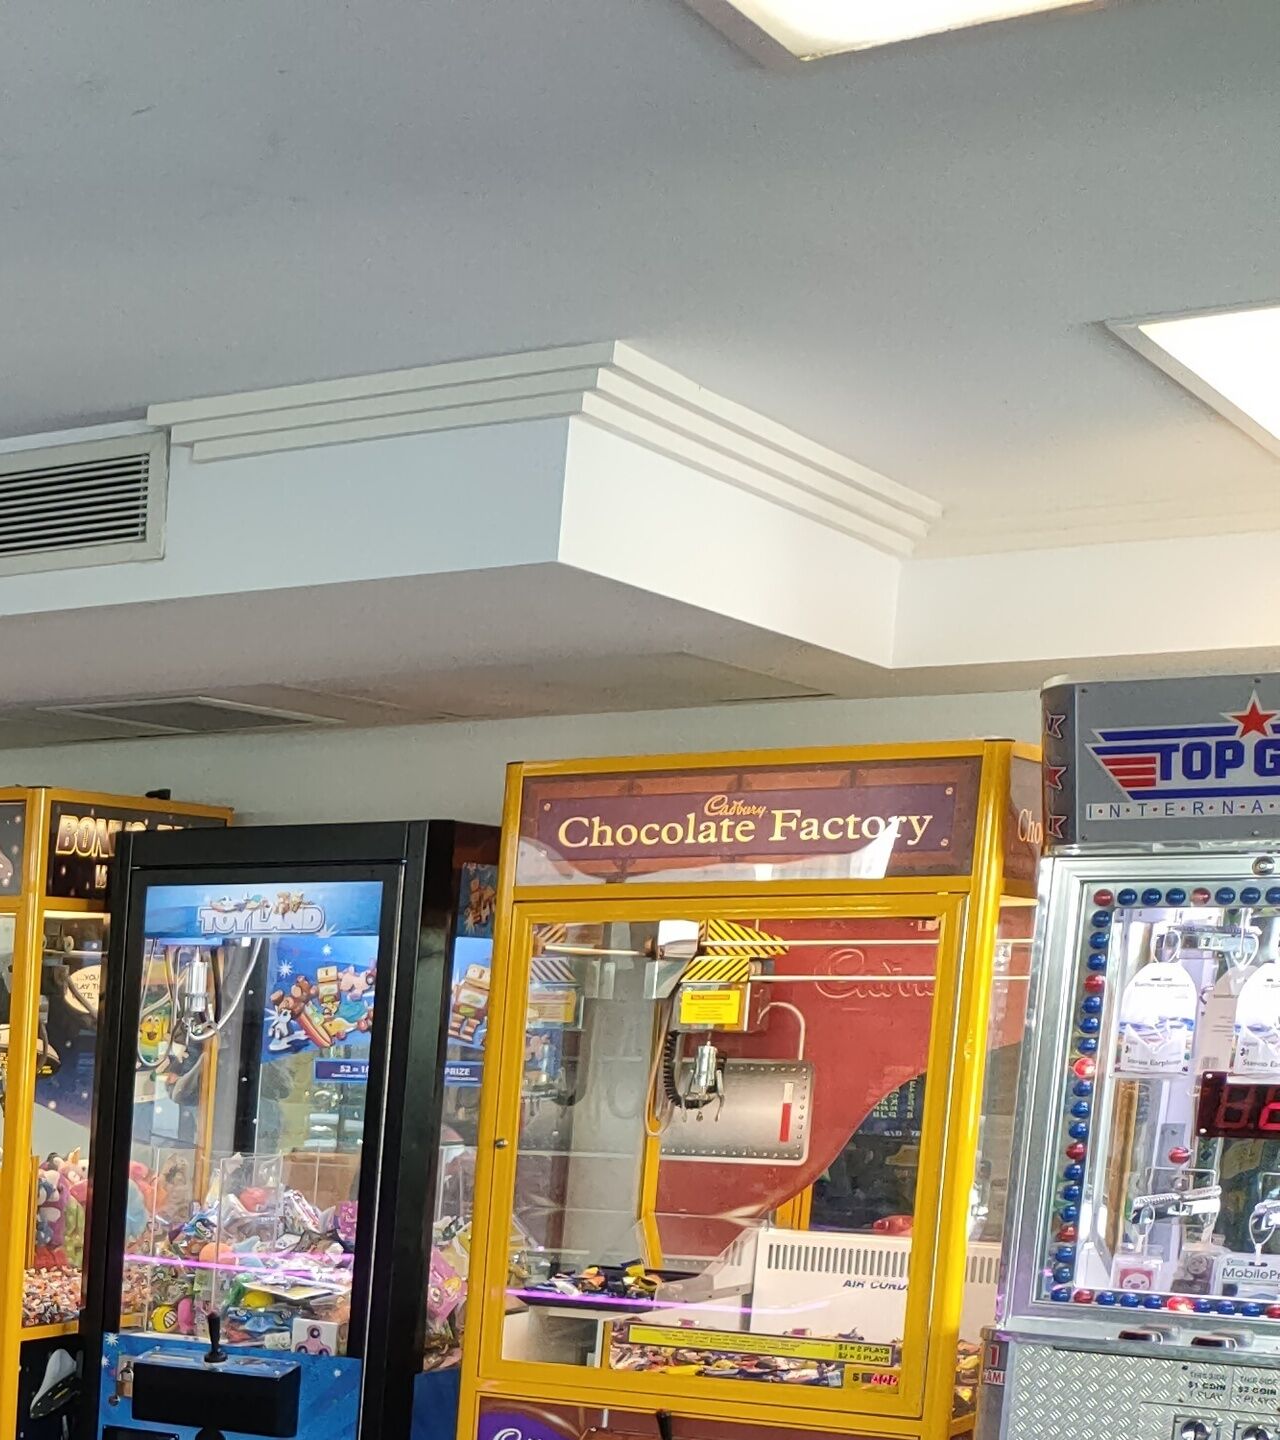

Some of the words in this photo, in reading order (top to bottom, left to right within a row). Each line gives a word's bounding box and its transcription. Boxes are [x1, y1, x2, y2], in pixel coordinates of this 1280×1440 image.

[1160, 739, 1245, 781] TOP
[704, 795, 768, 818] Cadbury
[557, 812, 756, 848] Chocolate
[768, 808, 934, 847] Factory
[55, 815, 147, 858] BON
[863, 1345, 890, 1355] PLAYS
[863, 1354, 890, 1363] PLAYS
[1202, 1381, 1226, 1391] COIN
[1252, 1386, 1277, 1396] COIN
